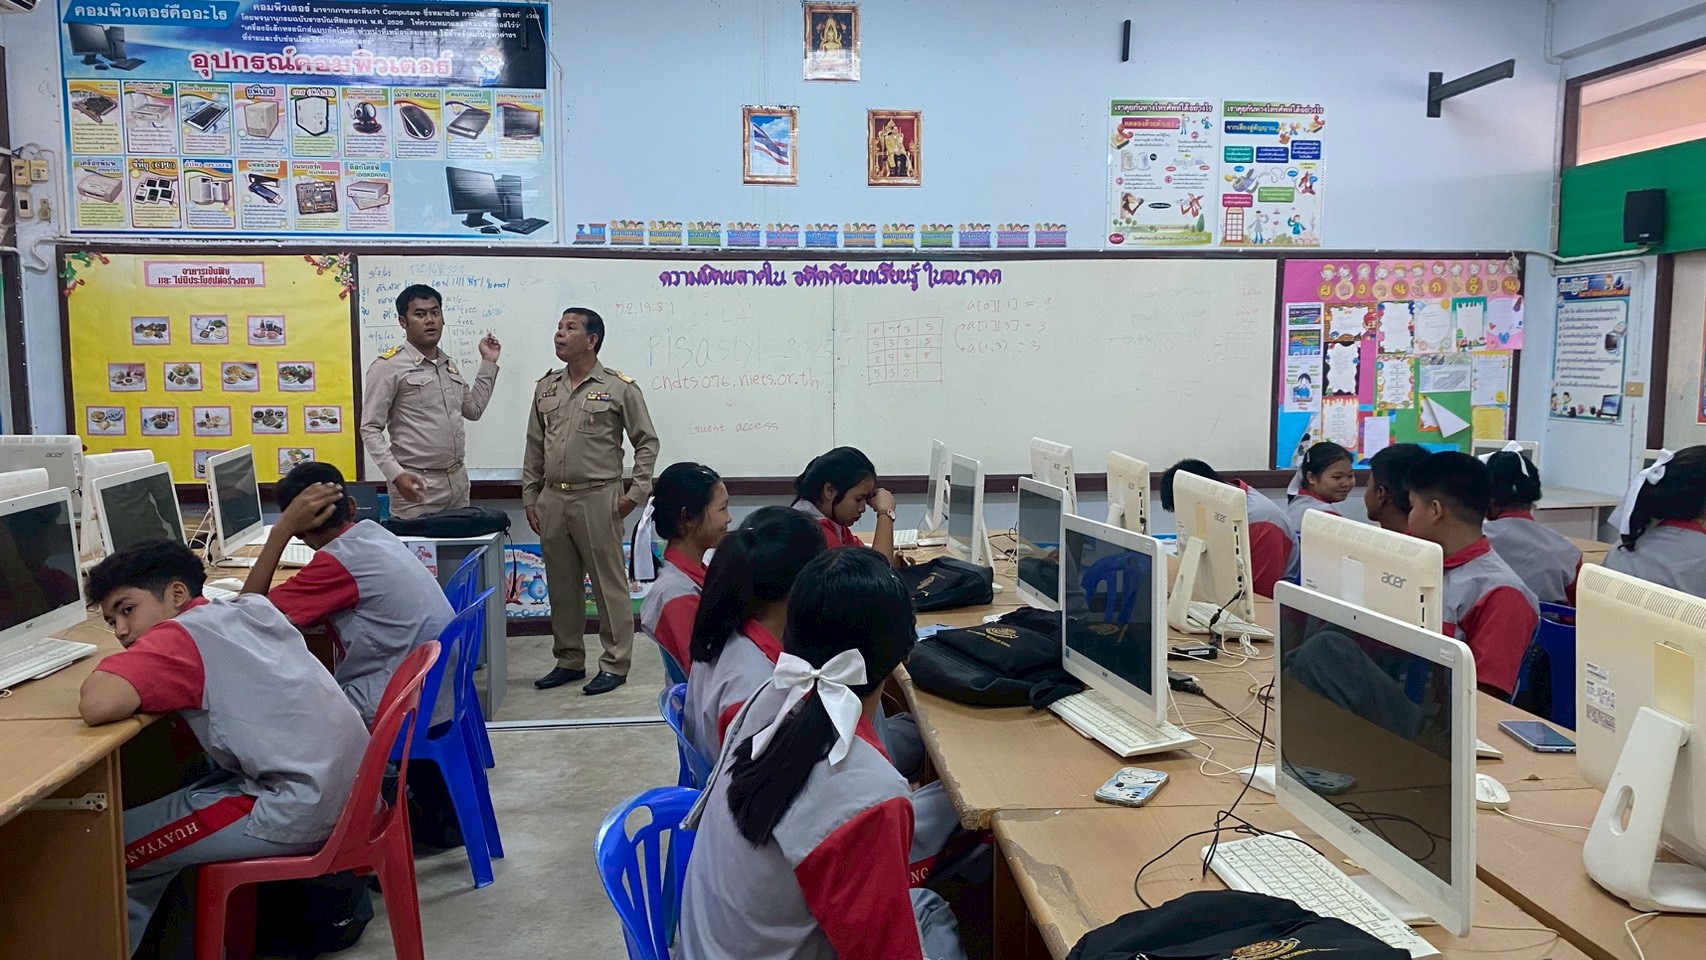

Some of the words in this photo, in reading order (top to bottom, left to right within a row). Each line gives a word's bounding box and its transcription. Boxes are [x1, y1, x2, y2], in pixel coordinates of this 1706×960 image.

[75, 3, 227, 20] คอมพิวเตอร์คืออะไร
[253, 2, 310, 13] คอมพิวเตอร์
[191, 48, 452, 79] อุปกรณ์คอมพิวเตอร์
[307, 88, 335, 97] (CASE)
[151, 160, 176, 169] (CPU)
[658, 261, 787, 287] ความผิดพลาดใน
[922, 260, 1002, 288] ในอนาคต
[736, 421, 779, 432] access
[1214, 512, 1227, 523] acer
[1381, 572, 1407, 589] acer
[126, 822, 199, 863] HUAYYAN
